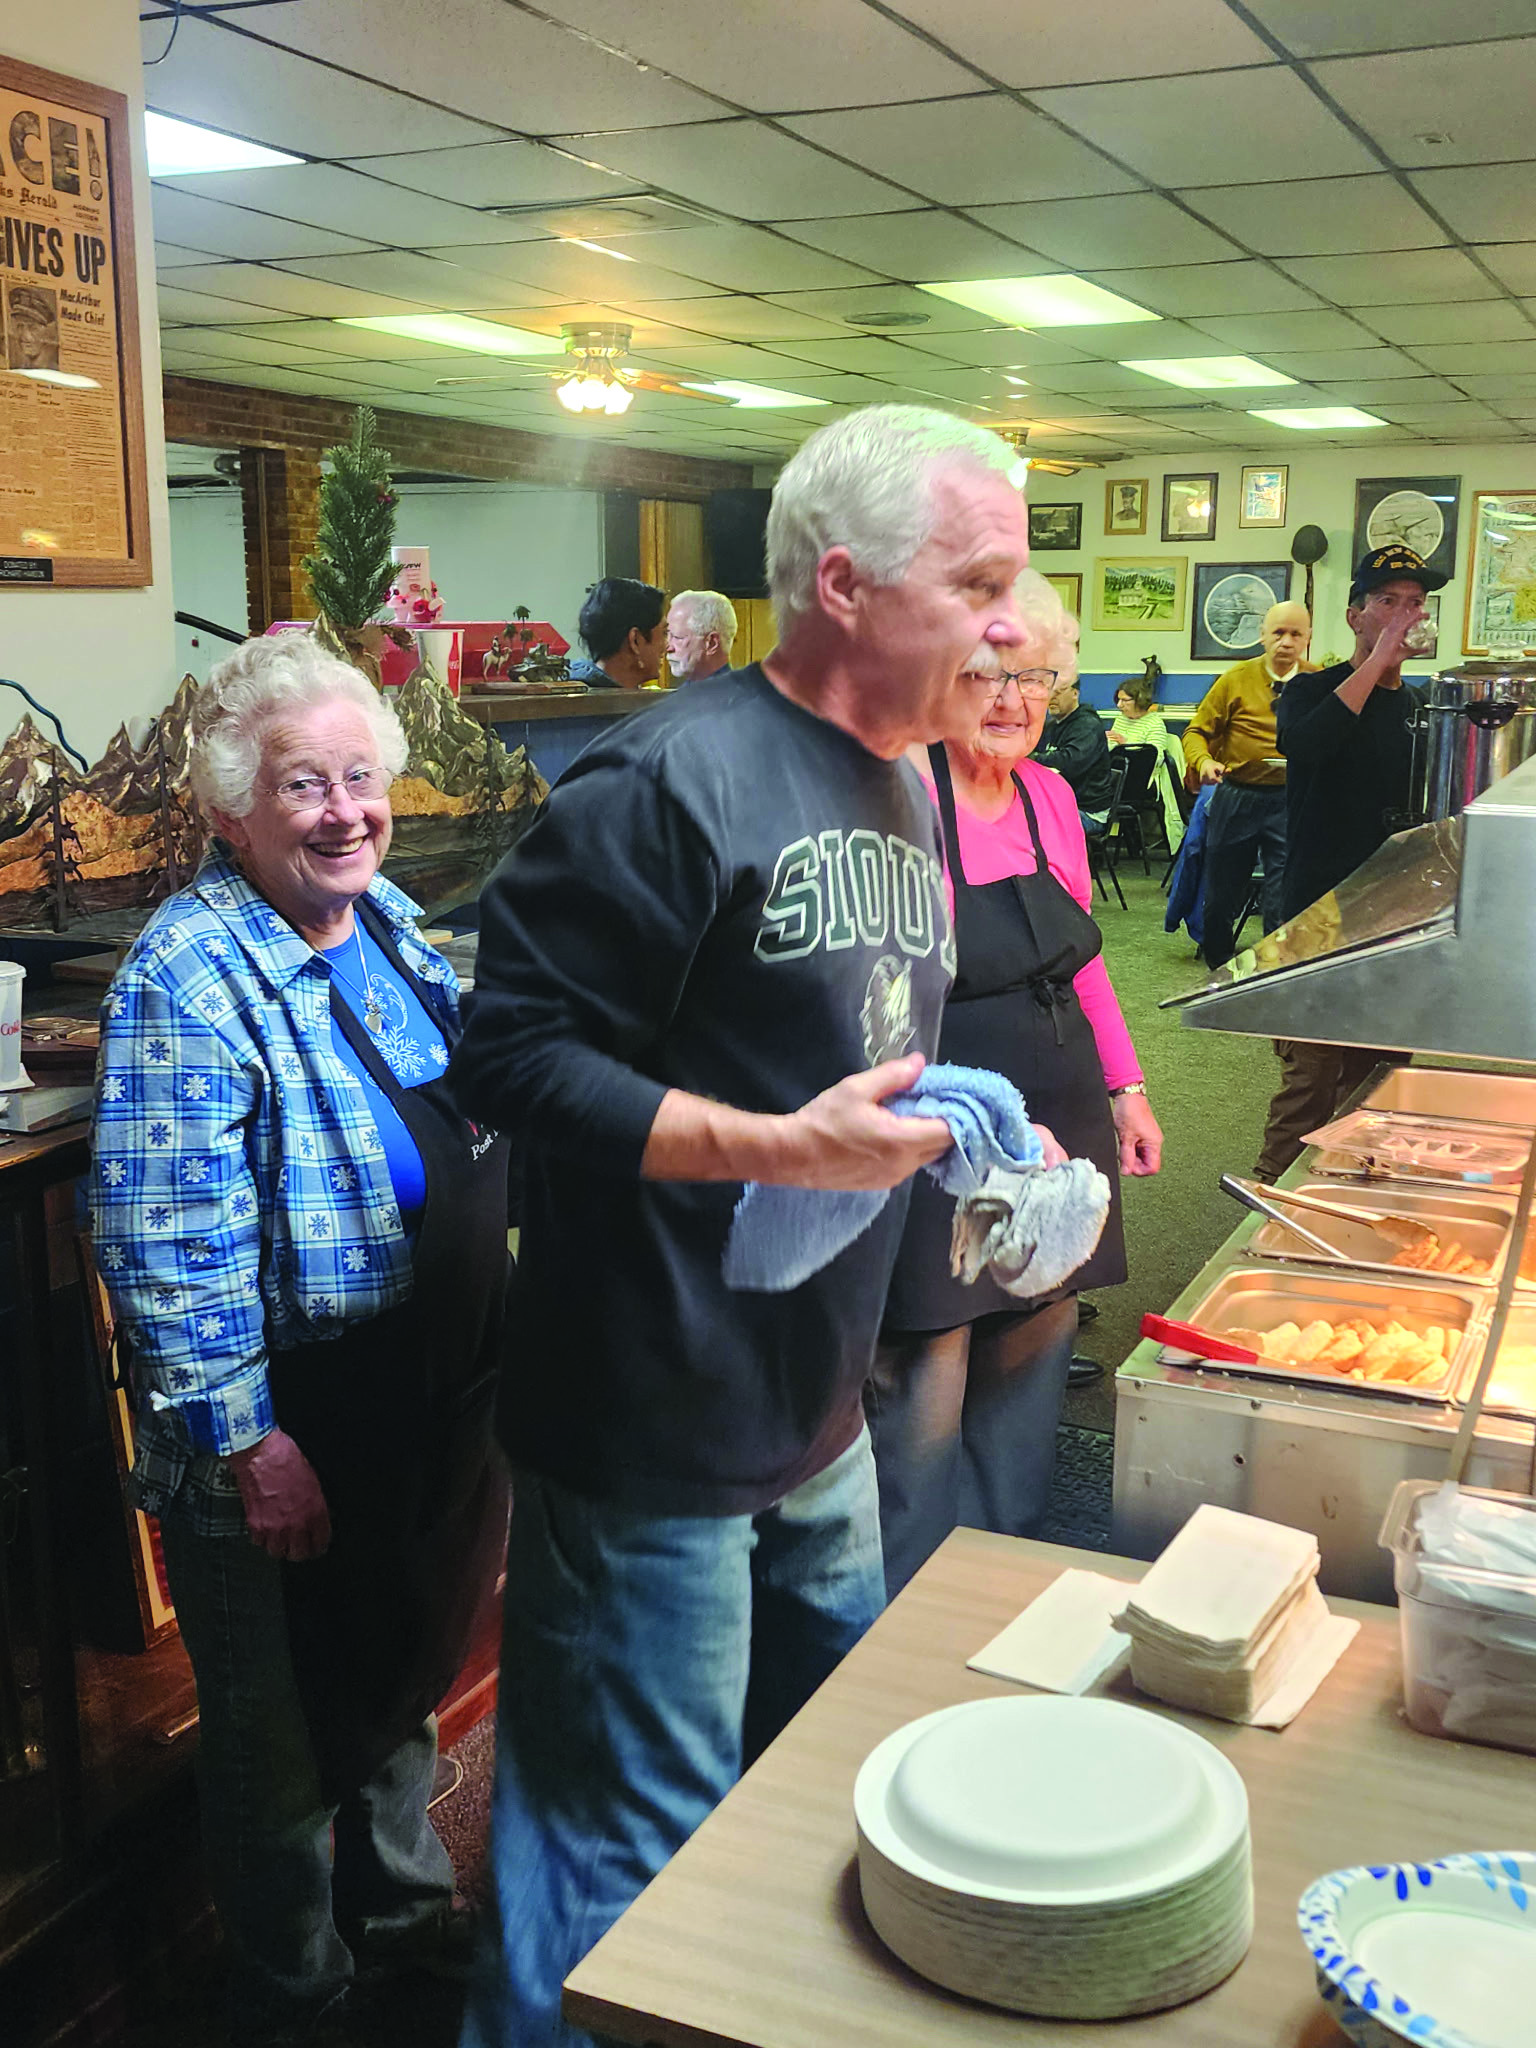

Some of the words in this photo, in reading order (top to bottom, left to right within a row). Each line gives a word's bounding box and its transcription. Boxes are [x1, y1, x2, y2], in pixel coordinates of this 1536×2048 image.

[0, 110, 103, 201] CE!
[20, 187, 57, 209] Herald
[74, 232, 106, 285] UP
[60, 288, 101, 307] MacArthur
[60, 306, 82, 322] Made
[84, 311, 105, 327] Chief
[471, 1133, 493, 1160] Post
